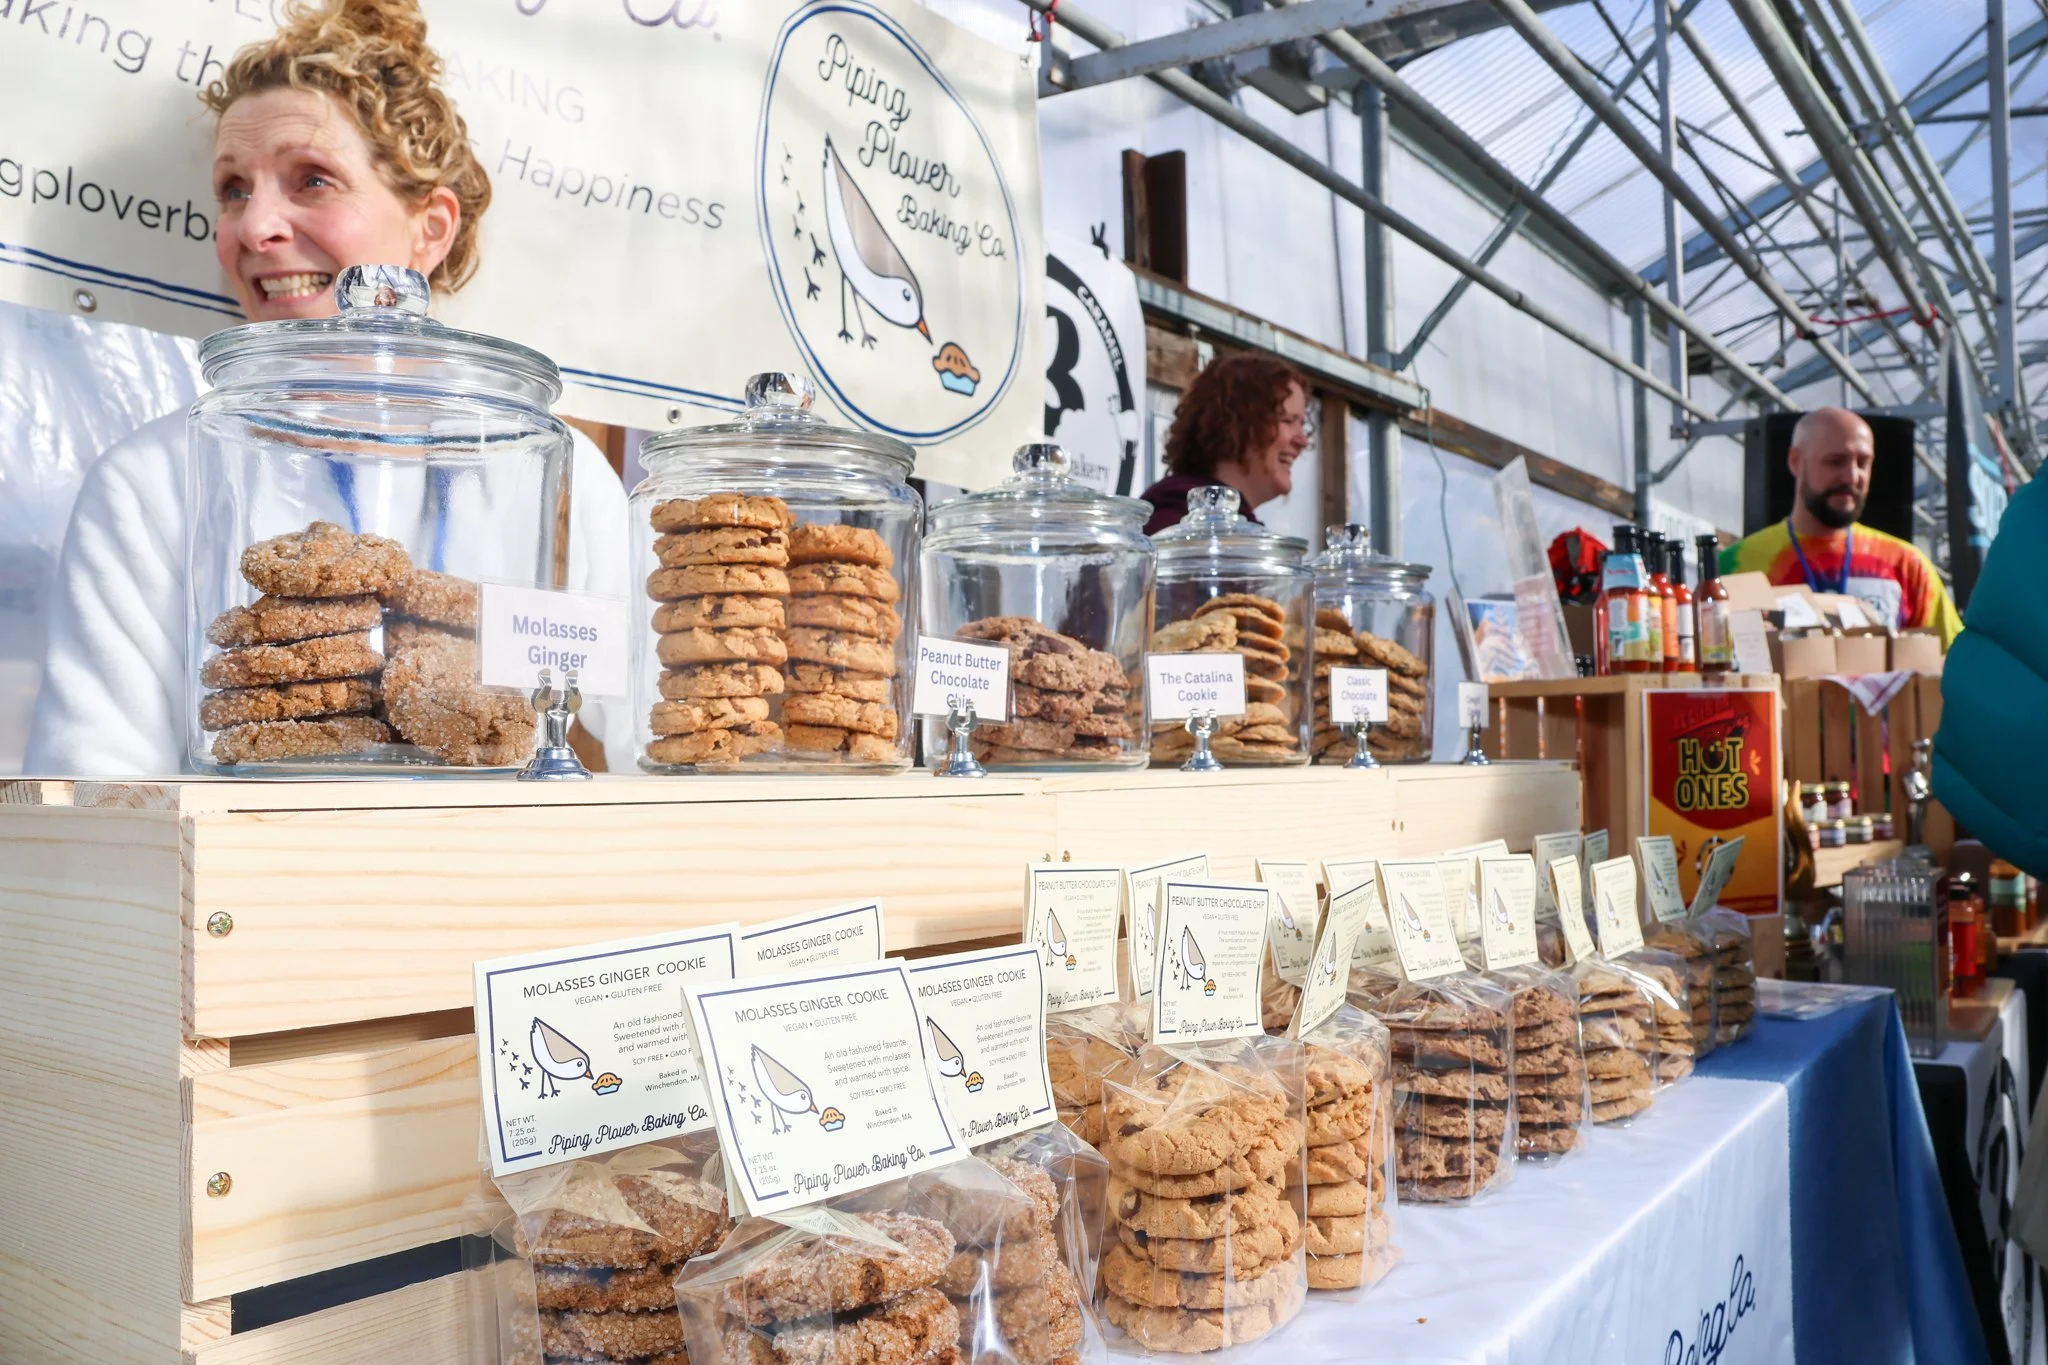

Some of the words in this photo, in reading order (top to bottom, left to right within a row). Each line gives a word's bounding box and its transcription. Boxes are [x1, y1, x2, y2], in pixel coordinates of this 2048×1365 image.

[818, 34, 911, 132] Piping
[858, 120, 961, 198] Plover
[497, 138, 726, 229] Happiness
[0, 158, 217, 242] gploverb
[897, 194, 972, 256] Baking
[1077, 286, 1124, 373] CARAMEL
[513, 615, 598, 642] Molasses
[528, 645, 588, 672] Ginger
[921, 647, 962, 666] Peanut
[965, 653, 1002, 671] Butter
[931, 670, 990, 690] Chocolate
[1160, 673, 1182, 685] The
[1184, 670, 1233, 684] Catalina
[1346, 676, 1372, 686] Classic
[1177, 689, 1218, 701] Cookie
[1341, 690, 1378, 701] Chocolate
[1677, 736, 1744, 774] HOT
[1674, 772, 1749, 811] ONES
[1038, 881, 1059, 891] PEANUT
[1059, 880, 1078, 890] BUTTER
[1077, 880, 1106, 889] CHOCOLATE
[1171, 896, 1196, 907] PEANUT
[1196, 897, 1218, 908] BUTTER
[1219, 898, 1252, 909] CHOCOLATE
[1253, 900, 1266, 909] CHIP
[757, 941, 800, 962] MOLASSES
[802, 933, 832, 950] GINGER
[834, 925, 864, 941] COOKIE
[788, 957, 806, 968] VEGAN
[809, 951, 828, 963] GLUTEN
[828, 948, 840, 957] FREE
[523, 975, 595, 999] MOLASSES
[599, 966, 650, 986] GINGER
[657, 957, 707, 976] COOKIE
[918, 980, 962, 998] MOLASSES
[963, 974, 995, 990] GINGER
[997, 968, 1027, 984] COOKIE
[574, 994, 603, 1005] VEGAN
[611, 987, 642, 1000] GLUTEN
[643, 983, 663, 994] FREE
[950, 997, 969, 1007] VEGAN
[972, 993, 992, 1003] GLUTEN
[992, 990, 1003, 999] FREE
[734, 1000, 798, 1024] MOLASSES
[799, 994, 843, 1013] GINGER
[847, 988, 889, 1005] COOKIE
[612, 1021, 625, 1031] An
[627, 1017, 641, 1028] old
[613, 1026, 661, 1043] Sweetened
[662, 1022, 680, 1033] with
[783, 1021, 808, 1033] VEGAN
[814, 1016, 841, 1028] GLUTEN
[841, 1013, 858, 1023] FREE
[976, 1023, 984, 1032] An
[618, 1042, 634, 1054] and
[636, 1036, 670, 1050] warmed
[672, 1031, 689, 1043] with
[976, 1030, 1004, 1044] Sweetened
[1004, 1027, 1014, 1037] with
[980, 1044, 990, 1054] and
[1009, 1037, 1018, 1047] with
[632, 1056, 646, 1066] SOY
[647, 1053, 664, 1063] FREE
[670, 1048, 687, 1058] GMO
[824, 1051, 835, 1061] An
[835, 1047, 848, 1058] old
[848, 1041, 881, 1056] fashioned
[827, 1059, 867, 1074] Sweetened
[867, 1056, 882, 1066] with
[882, 1050, 911, 1063] molasses
[645, 1077, 690, 1092] Winchendon,
[658, 1069, 680, 1080] Baked
[834, 1075, 848, 1087] and
[849, 1069, 877, 1083] warmed
[878, 1066, 892, 1077] with
[892, 1064, 911, 1076] spice.
[849, 1091, 861, 1101] SOY
[861, 1088, 875, 1097] FREE
[879, 1084, 894, 1094] GMO
[894, 1081, 907, 1090] FREE
[505, 1117, 522, 1128] NET
[522, 1115, 537, 1125] WT.
[865, 1115, 901, 1129] Winchendon,
[901, 1112, 912, 1120] MA
[875, 1107, 892, 1117] Baked
[508, 1128, 525, 1138] 7.25
[526, 1127, 538, 1135] oz.
[548, 1131, 592, 1155] Piping
[595, 1122, 640, 1145] Plover
[641, 1110, 687, 1132] Baking
[687, 1104, 709, 1121] Co.
[968, 1120, 994, 1138] Plover
[994, 1110, 1019, 1128] Baking
[512, 1135, 538, 1149] (205g)
[748, 1154, 763, 1165] NET
[763, 1151, 777, 1161] WT.
[753, 1165, 769, 1176] 7.25
[769, 1163, 779, 1172] oz.
[793, 1170, 831, 1195] Piping
[833, 1161, 871, 1185] Plover
[871, 1149, 909, 1173] Baking
[907, 1144, 927, 1162] Co.
[758, 1173, 781, 1187] (205g)
[1728, 1253, 1756, 1335] Co.
